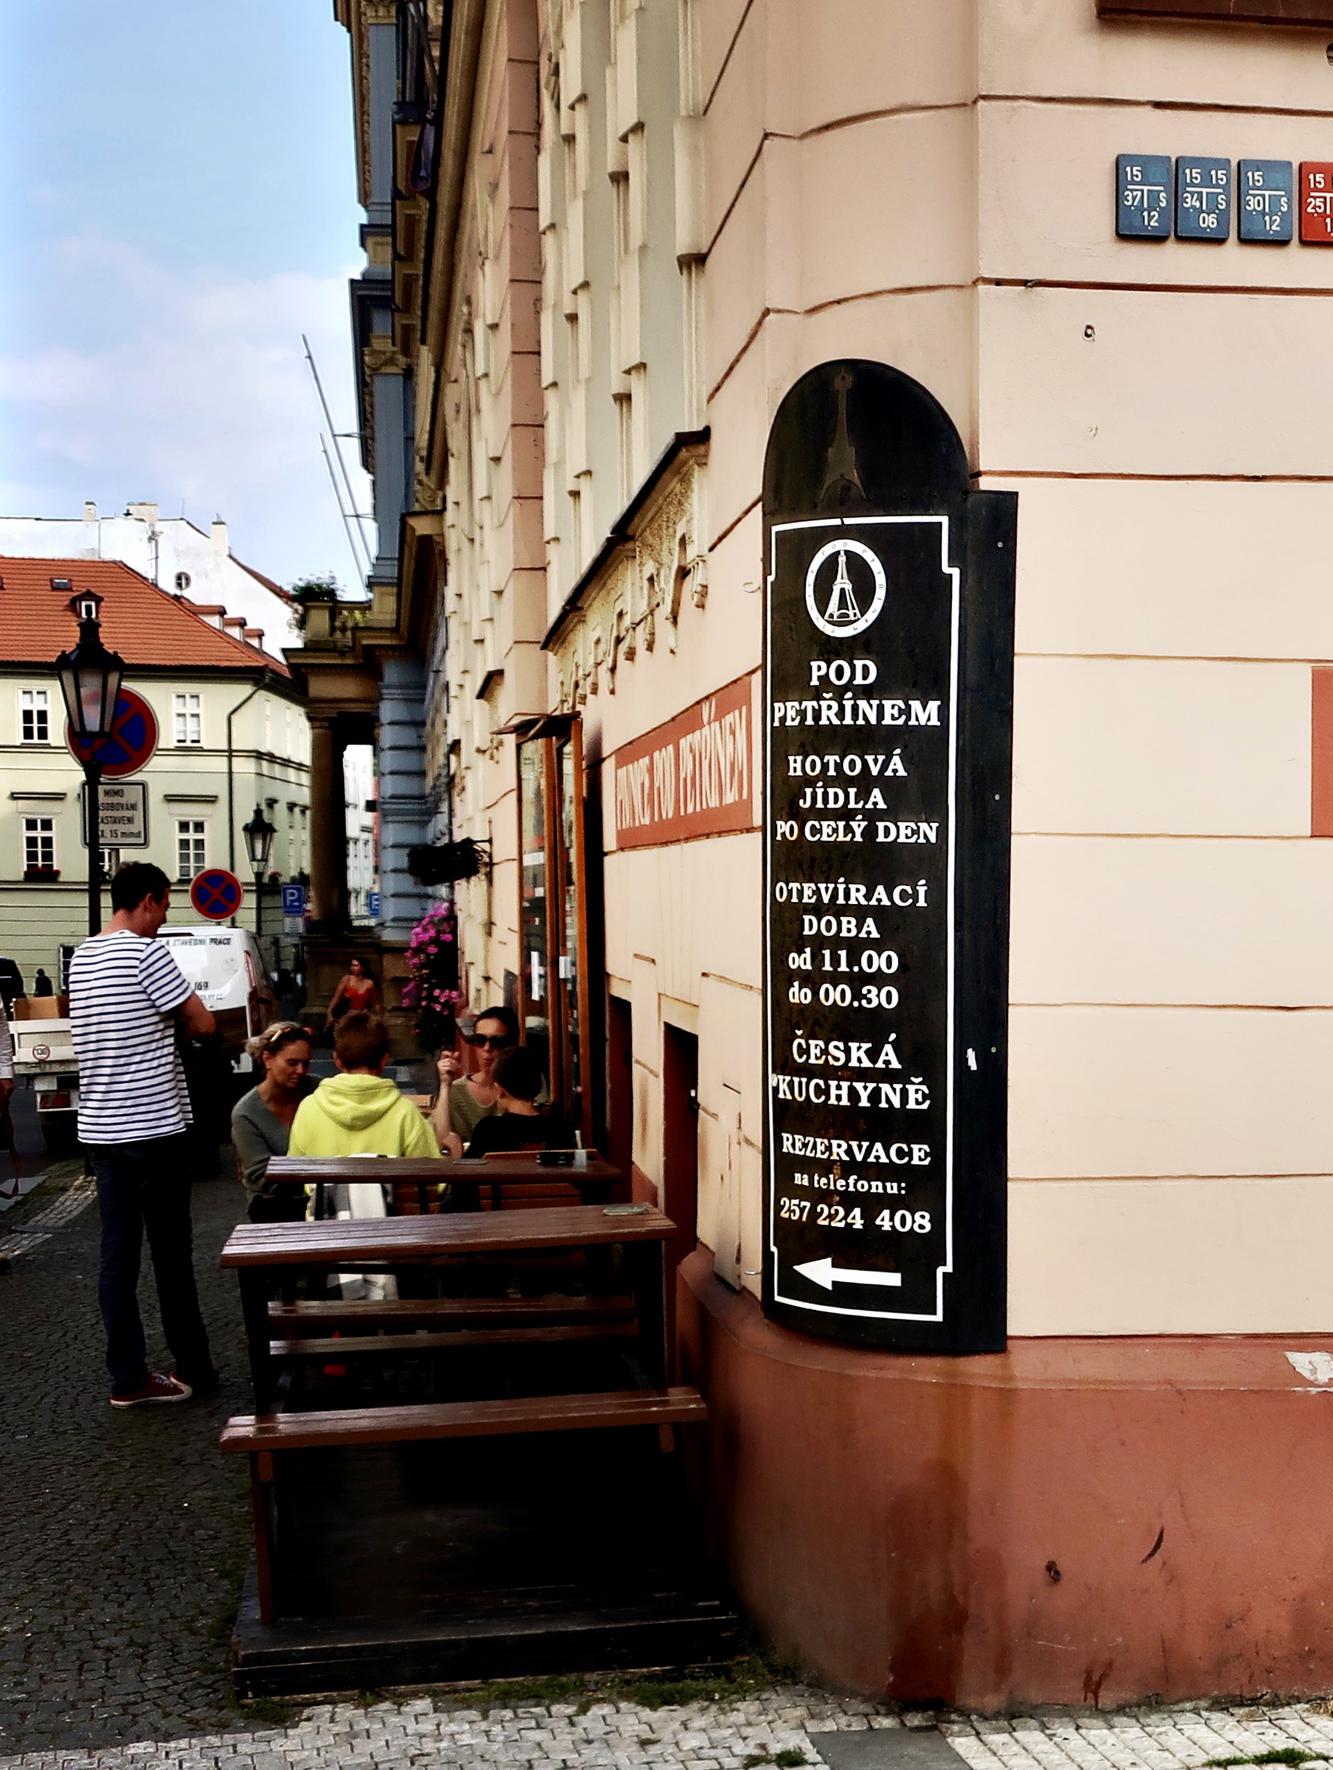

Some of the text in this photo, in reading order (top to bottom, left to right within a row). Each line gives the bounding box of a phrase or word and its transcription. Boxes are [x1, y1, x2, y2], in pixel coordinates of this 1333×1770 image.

[1125, 166, 1142, 181] 15
[1184, 168, 1227, 185] 15 15
[1246, 171, 1263, 186] 15
[1308, 173, 1325, 189] 15
[1159, 192, 1167, 208] S
[1217, 194, 1227, 210] S
[1280, 196, 1288, 212] S
[810, 659, 877, 686] POD
[772, 691, 941, 728] PETŘÍNEM
[652, 743, 676, 822] POD
[678, 698, 748, 816] PETŘÍNEM
[788, 749, 907, 777] HOTOVÁ
[799, 782, 887, 810] JÍDLA
[775, 815, 939, 844] PO CELÝ DEN
[775, 877, 928, 908] OTEVÍRACÍ
[802, 915, 880, 939] DOBA
[788, 948, 898, 974] od 11.00
[788, 983, 898, 1009] do 00.30
[792, 1030, 901, 1069] ČESKÁ
[778, 1075, 931, 1111] KUCHYNĚ
[781, 1132, 931, 1166] REZERVACE
[794, 1171, 906, 1195] na telefonu:
[780, 1197, 931, 1234] 257 224 408
